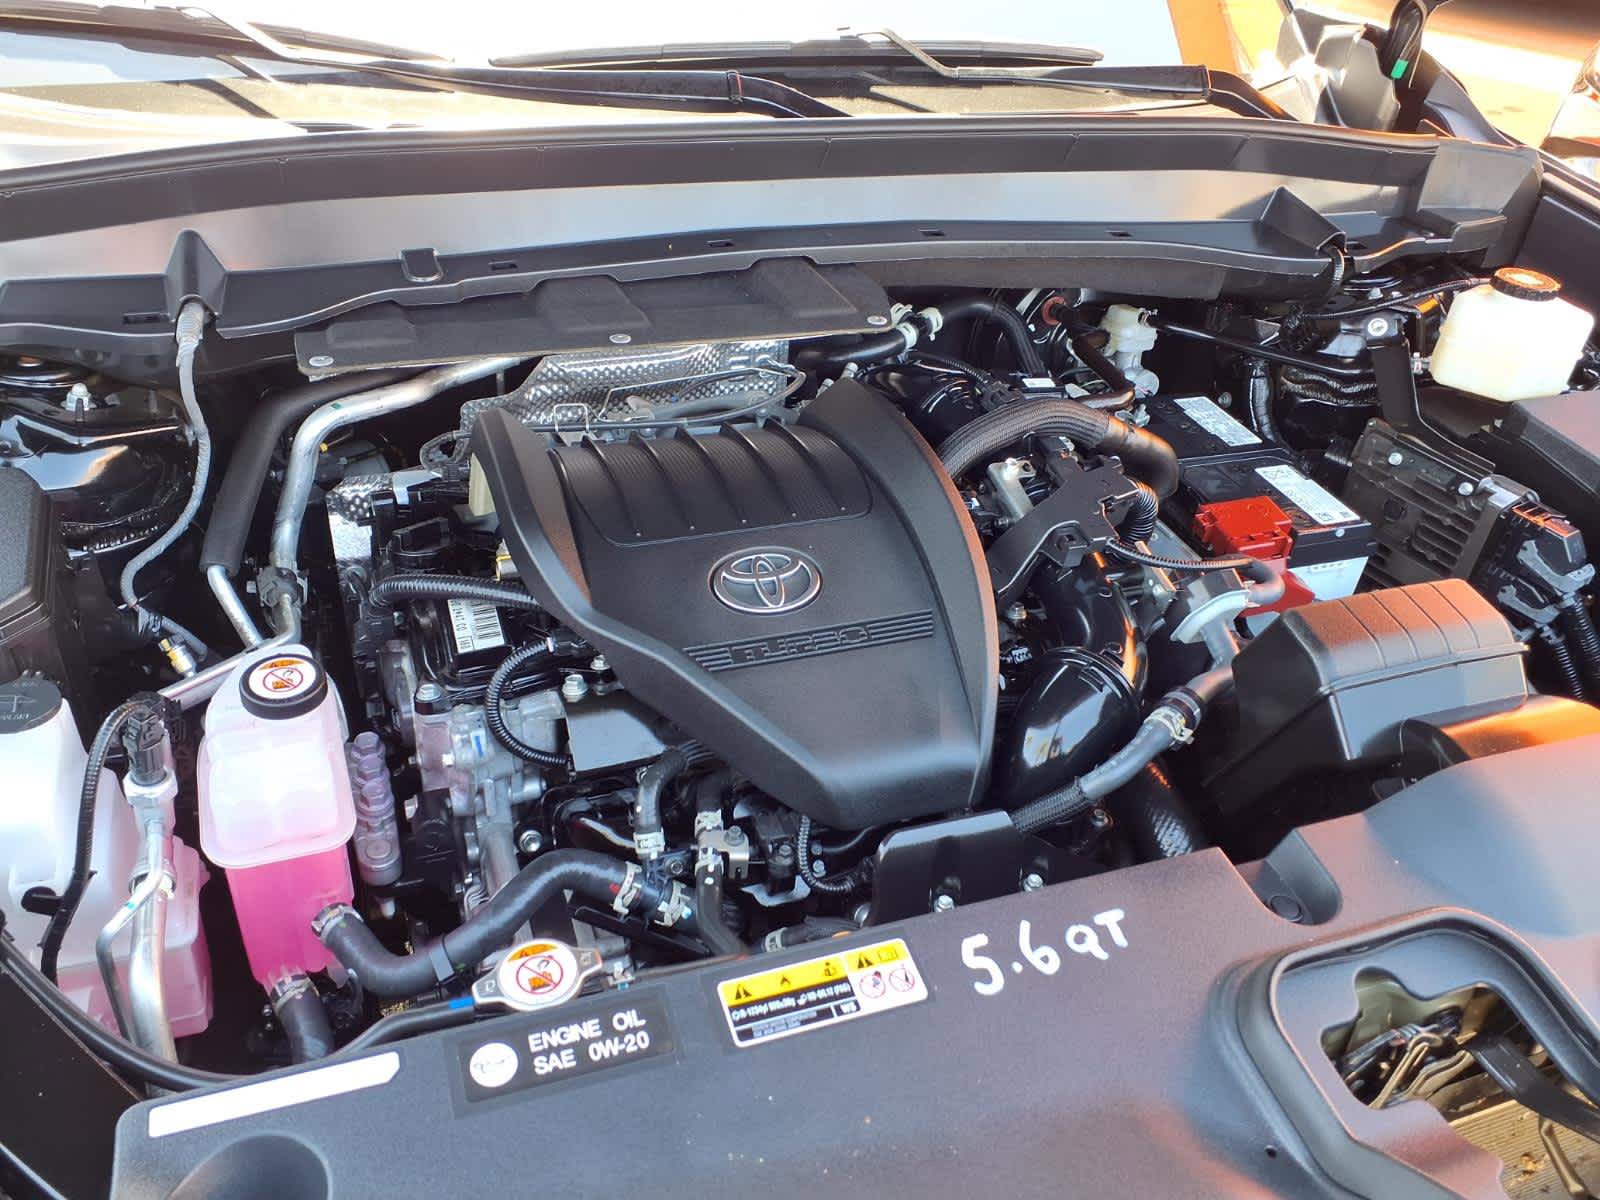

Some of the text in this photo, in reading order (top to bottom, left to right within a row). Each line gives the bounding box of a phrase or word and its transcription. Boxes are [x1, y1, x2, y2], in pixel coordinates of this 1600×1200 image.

[731, 626, 870, 661] TURBO
[961, 919, 1061, 995] 5.6
[527, 1008, 647, 1053] ENGINE OIL
[533, 1048, 577, 1075] SAE
[588, 1031, 650, 1061] 0W-20
